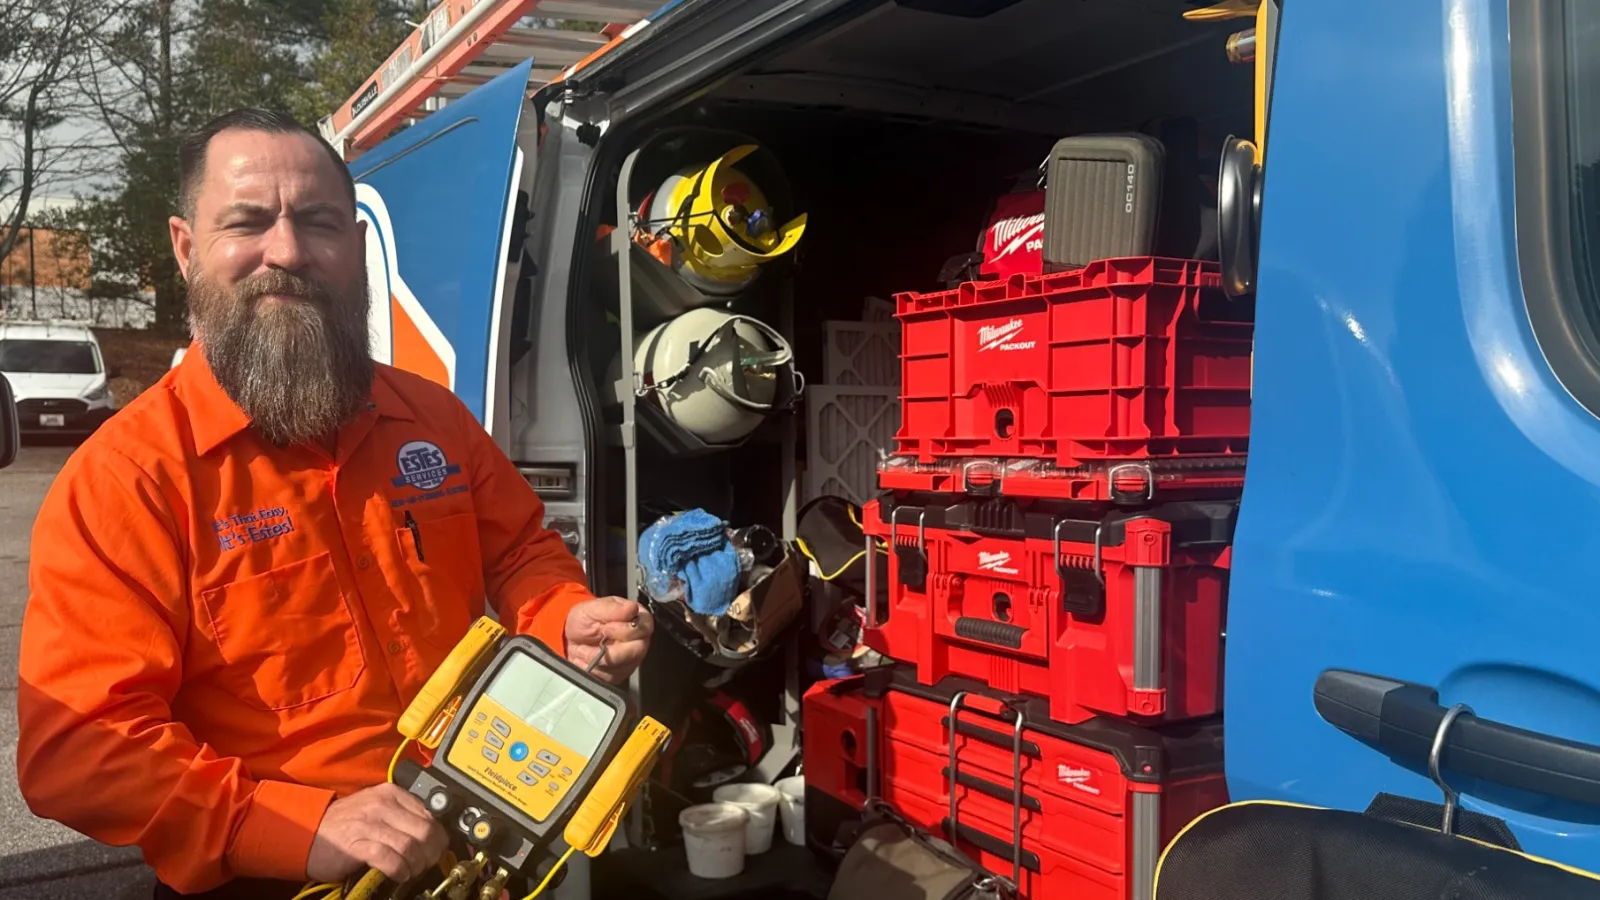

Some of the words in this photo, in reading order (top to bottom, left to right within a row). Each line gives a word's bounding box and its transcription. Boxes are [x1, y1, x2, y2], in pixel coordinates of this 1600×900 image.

[1125, 163, 1134, 213] OC140
[1026, 238, 1044, 252] PA
[977, 318, 1024, 346] Milwaukee
[999, 341, 1036, 351] PACKOUT
[400, 446, 443, 474] ESTES
[405, 467, 448, 483] SERVICES
[231, 514, 257, 526] That
[218, 532, 246, 552] It's
[248, 516, 295, 542] Estes!
[484, 766, 518, 792] Fieldpiece
